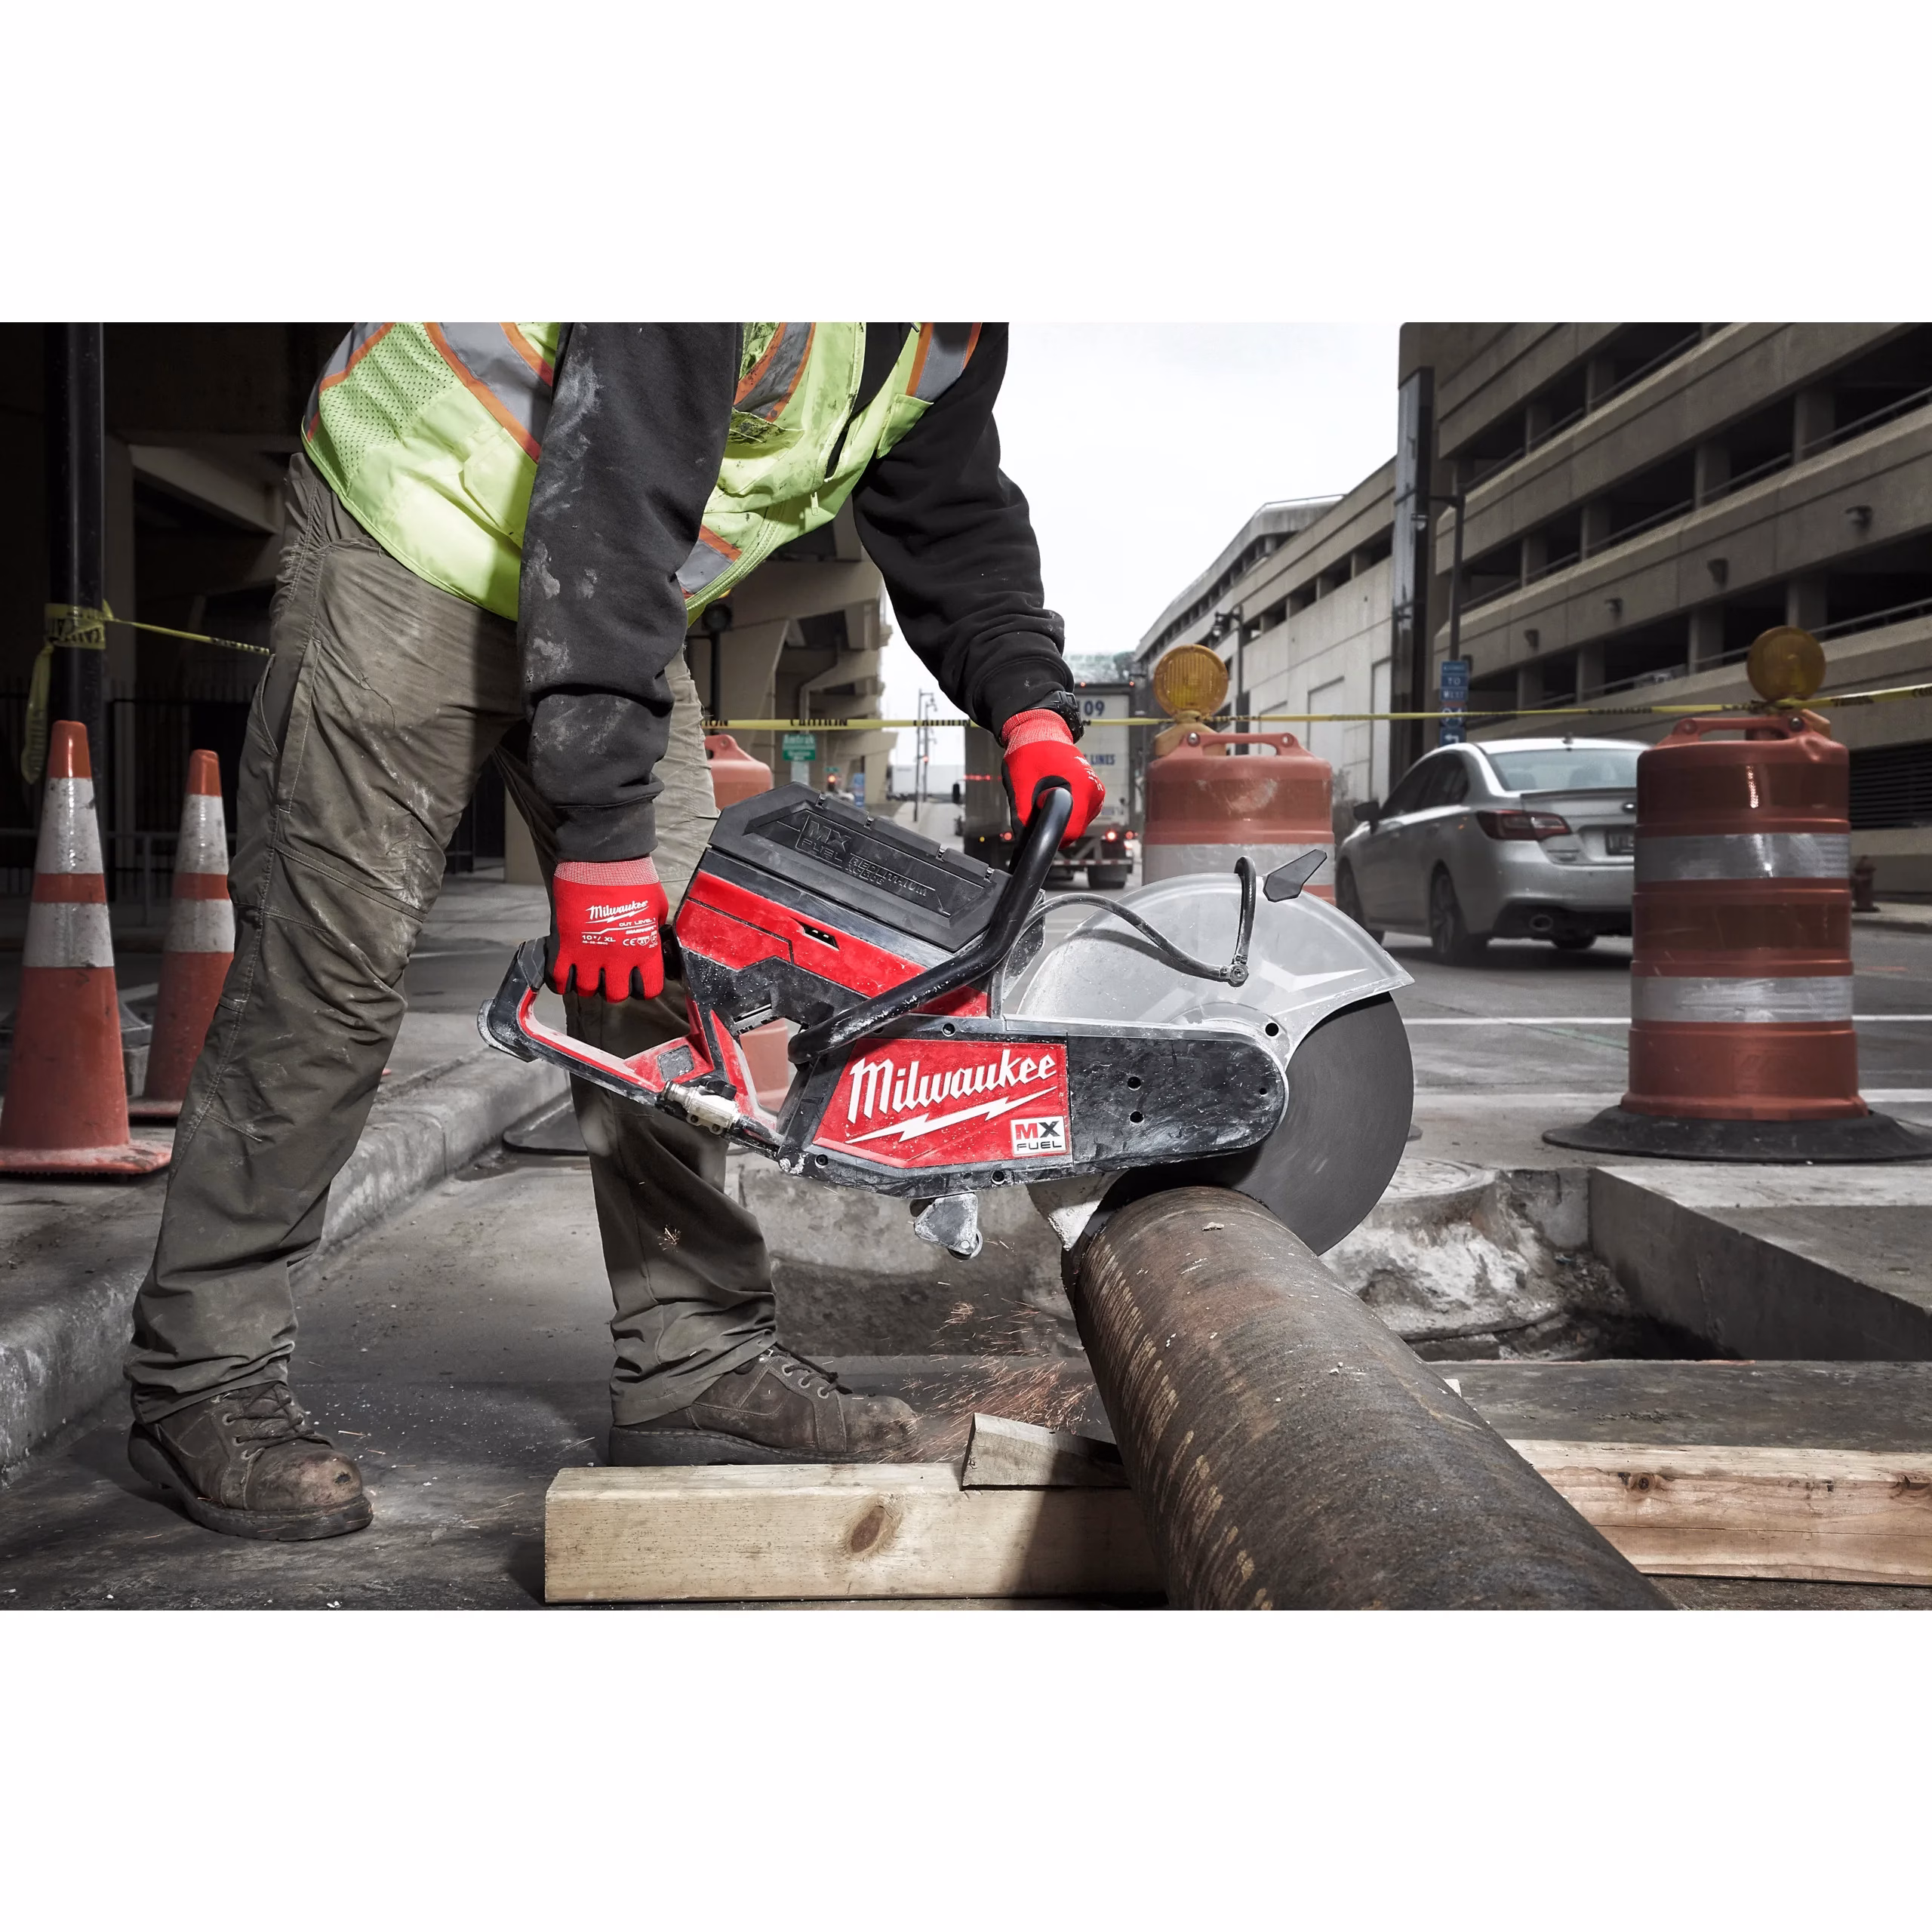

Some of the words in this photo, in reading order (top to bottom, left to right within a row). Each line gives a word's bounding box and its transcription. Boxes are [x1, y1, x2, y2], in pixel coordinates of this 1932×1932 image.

[1447, 677, 1461, 685] TO
[801, 838, 843, 863] FUEL
[586, 900, 648, 920] Milwaukee
[847, 1049, 1057, 1124] Milwaukee
[1015, 1121, 1061, 1140] MX
[1017, 1140, 1063, 1152] FUEL
